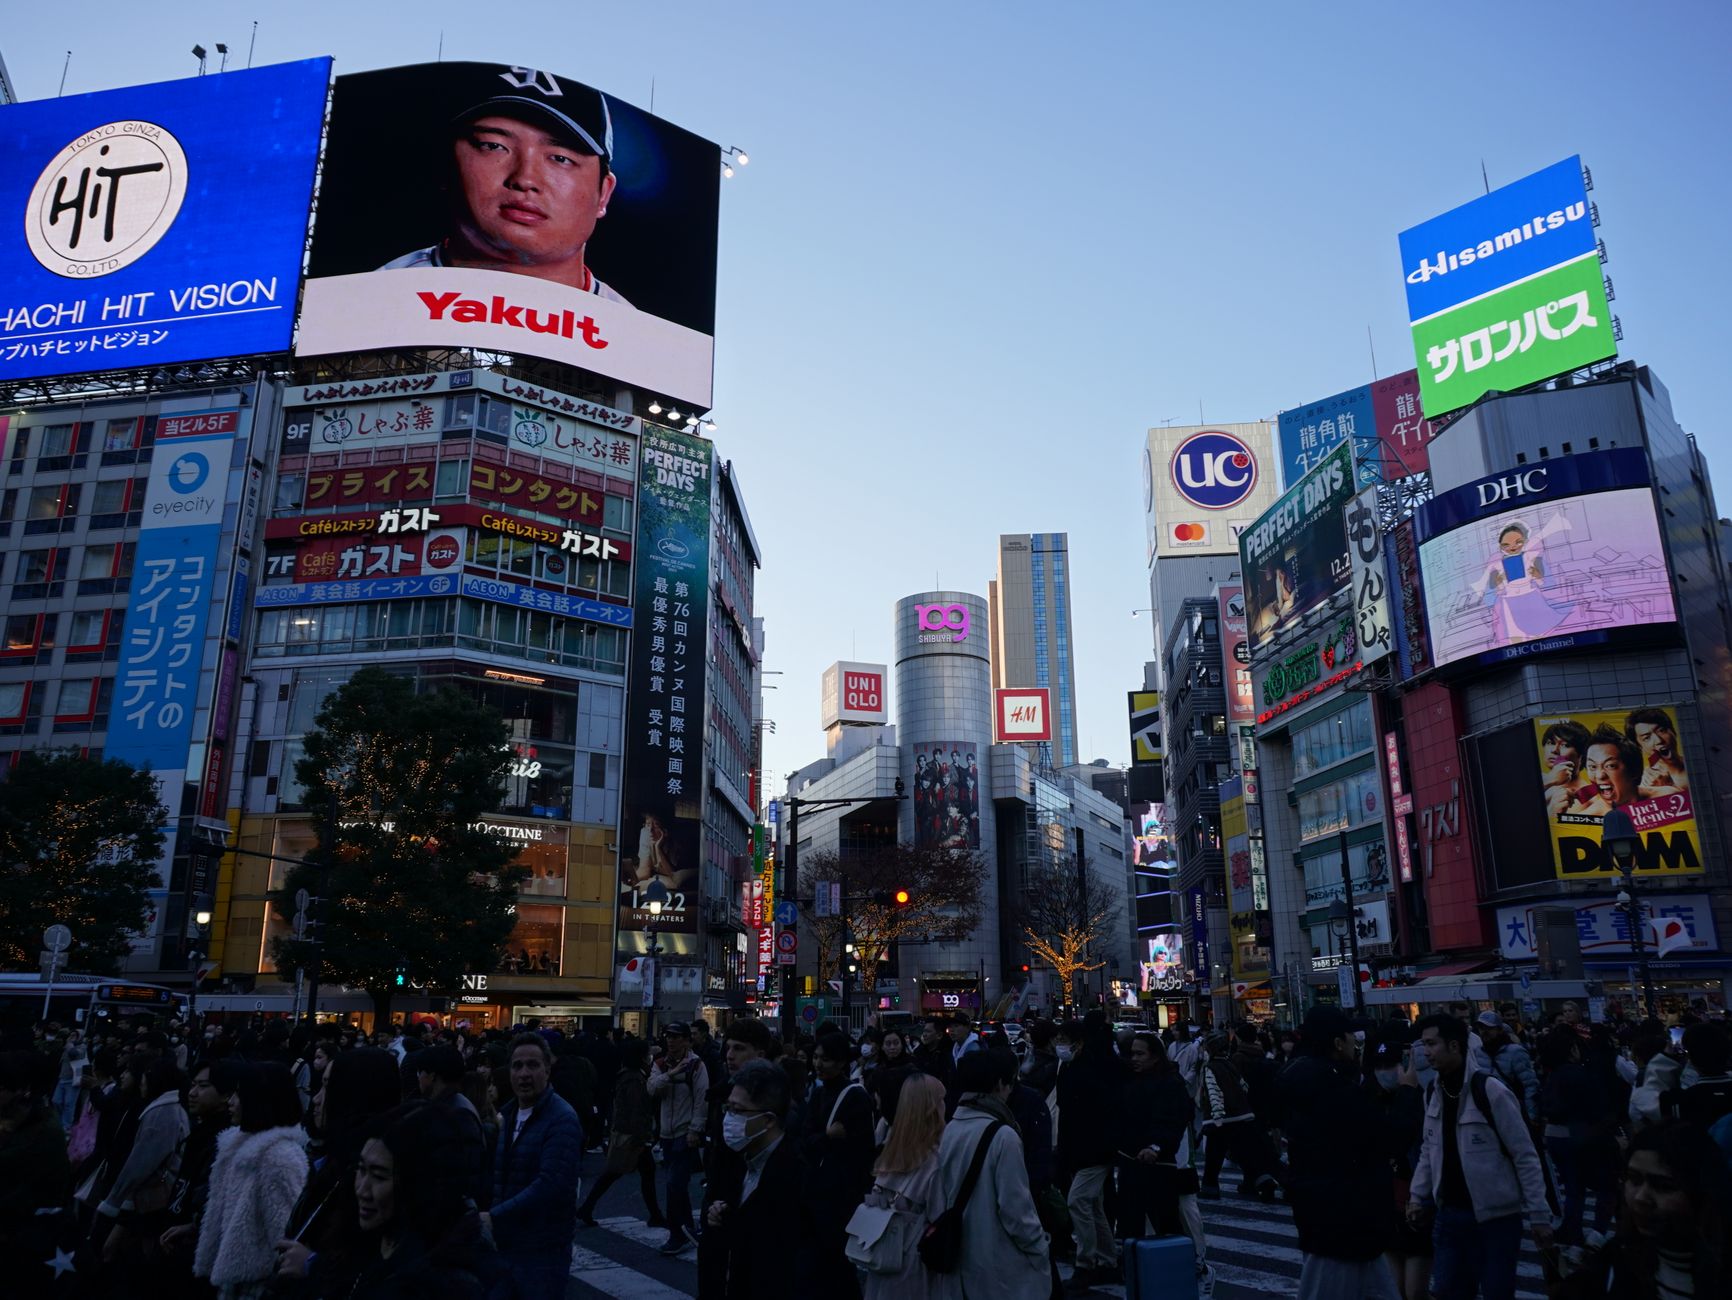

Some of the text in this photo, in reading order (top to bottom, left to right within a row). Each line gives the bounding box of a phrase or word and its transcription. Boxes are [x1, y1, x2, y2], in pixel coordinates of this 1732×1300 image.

[70, 122, 160, 153] TOKYO GINZA
[1407, 201, 1585, 284] Hisamitsu
[66, 259, 121, 275] CO.,LTD.
[102, 292, 155, 320] HIT
[169, 277, 277, 312] VISION
[416, 291, 609, 350] Yakult
[1426, 290, 1598, 383] サロンパス
[165, 415, 230, 436] 当ビル5F
[287, 423, 310, 440] 9F
[358, 405, 434, 436] しゃぶ葉
[1300, 411, 1356, 450] 龍角散
[554, 424, 631, 465] しゃぶ葉
[644, 448, 709, 480] PERFECT
[1180, 451, 1249, 488] UC
[310, 467, 430, 500] プライス
[472, 465, 599, 515] コンタクト
[656, 468, 695, 492] DAYS
[1476, 468, 1549, 507] DHC
[152, 497, 215, 518] eyecity
[378, 507, 440, 534] ガスト
[1246, 459, 1344, 564] PERFECT DAYS
[560, 530, 620, 560] ガスト
[267, 555, 296, 575] 7F
[337, 544, 415, 578] ガスト
[1348, 500, 1391, 651] もんじゃ
[262, 588, 298, 601] AEON
[310, 580, 424, 601] 英会話イーオン
[431, 577, 449, 591] 6F
[469, 579, 630, 628] AEON 英会話イーオン
[914, 604, 971, 642] 109
[918, 634, 952, 643] SHIBUYA
[122, 559, 176, 729] アイシティ
[158, 556, 205, 729] コンタクトの
[1506, 637, 1575, 658] DHC Channel
[647, 576, 669, 747] 最優秀男優賞 受賞
[666, 581, 690, 795] 第76回カンヌ国際映画祭
[848, 676, 875, 691] UNI
[848, 693, 878, 708] QLO
[1010, 705, 1037, 723] H&M
[1628, 800, 1659, 817] Inci
[1194, 893, 1203, 921] MIZUHO
[942, 994, 959, 1007] 109
